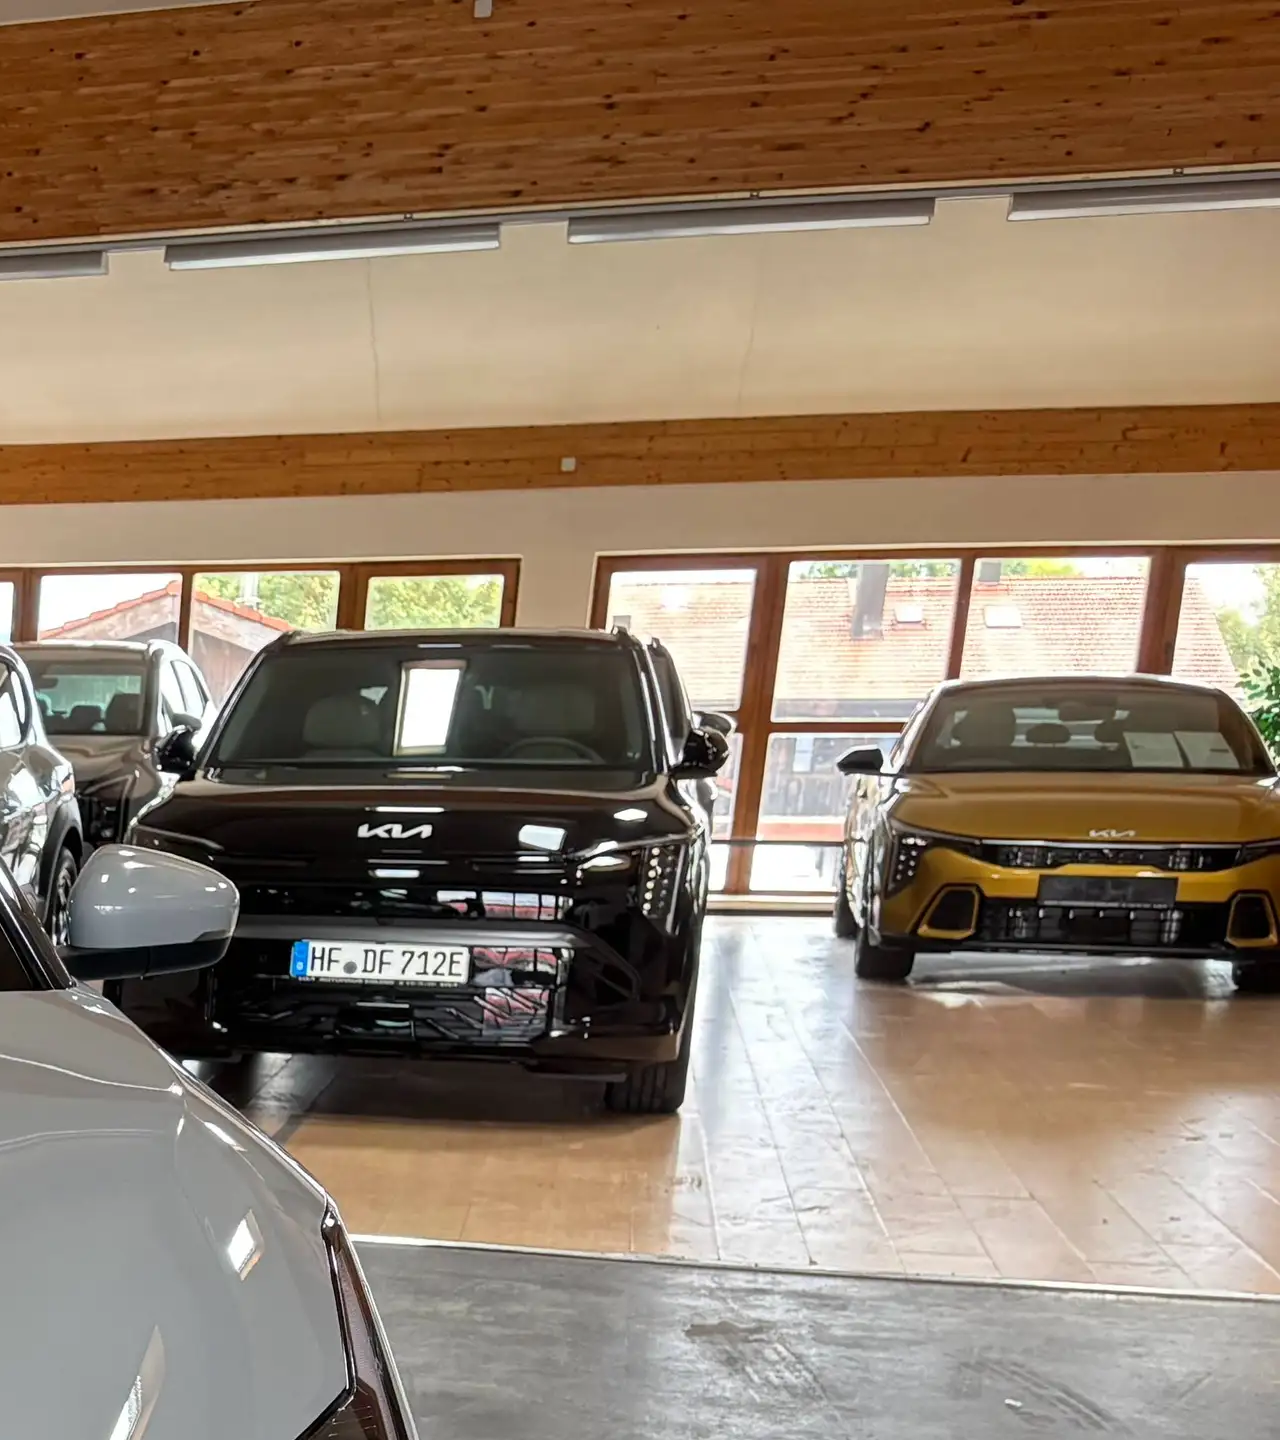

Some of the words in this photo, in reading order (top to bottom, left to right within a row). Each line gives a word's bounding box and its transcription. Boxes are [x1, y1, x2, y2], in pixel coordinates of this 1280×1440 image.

[357, 823, 433, 839] KIA
[310, 946, 342, 972] HF
[361, 948, 394, 974] DF
[400, 950, 464, 977] 712E
